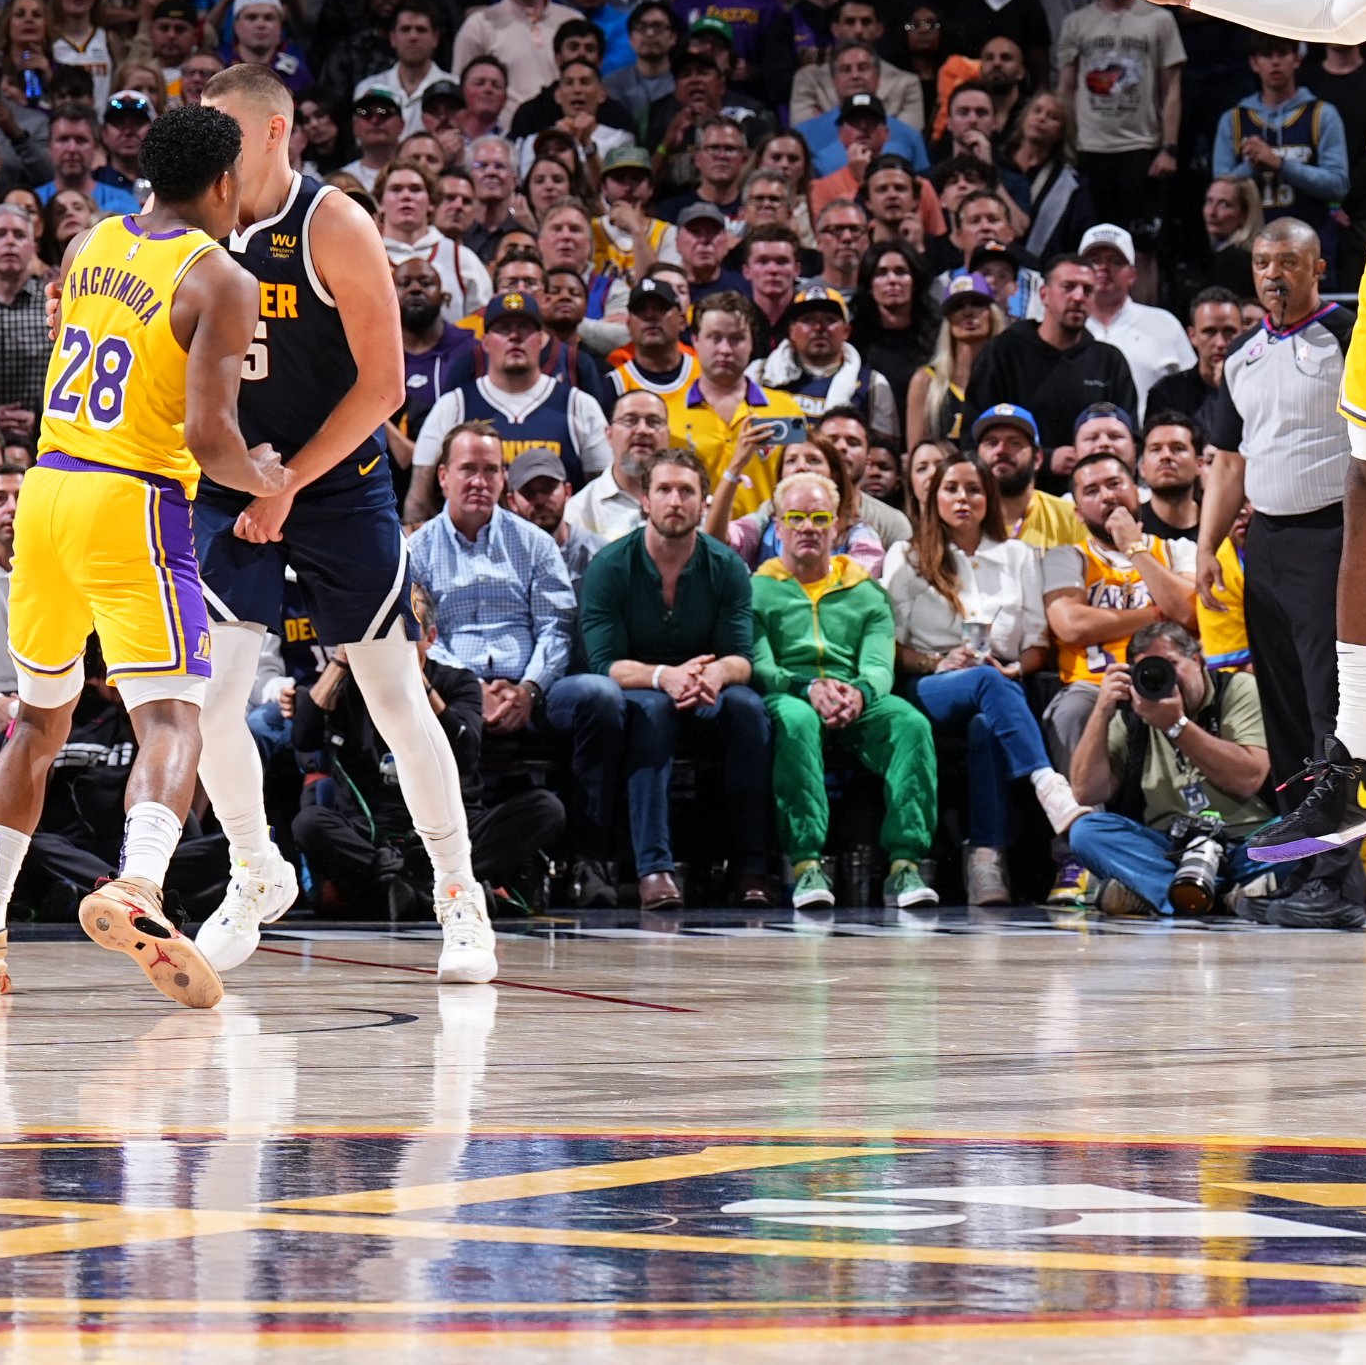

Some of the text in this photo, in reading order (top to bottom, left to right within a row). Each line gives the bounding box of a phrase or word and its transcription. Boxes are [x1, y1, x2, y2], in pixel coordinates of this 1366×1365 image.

[268, 246, 296, 257] Western
[270, 232, 298, 251] WU
[69, 266, 166, 327] HACHIMURA
[45, 324, 135, 432] 28
[242, 320, 270, 381] 5
